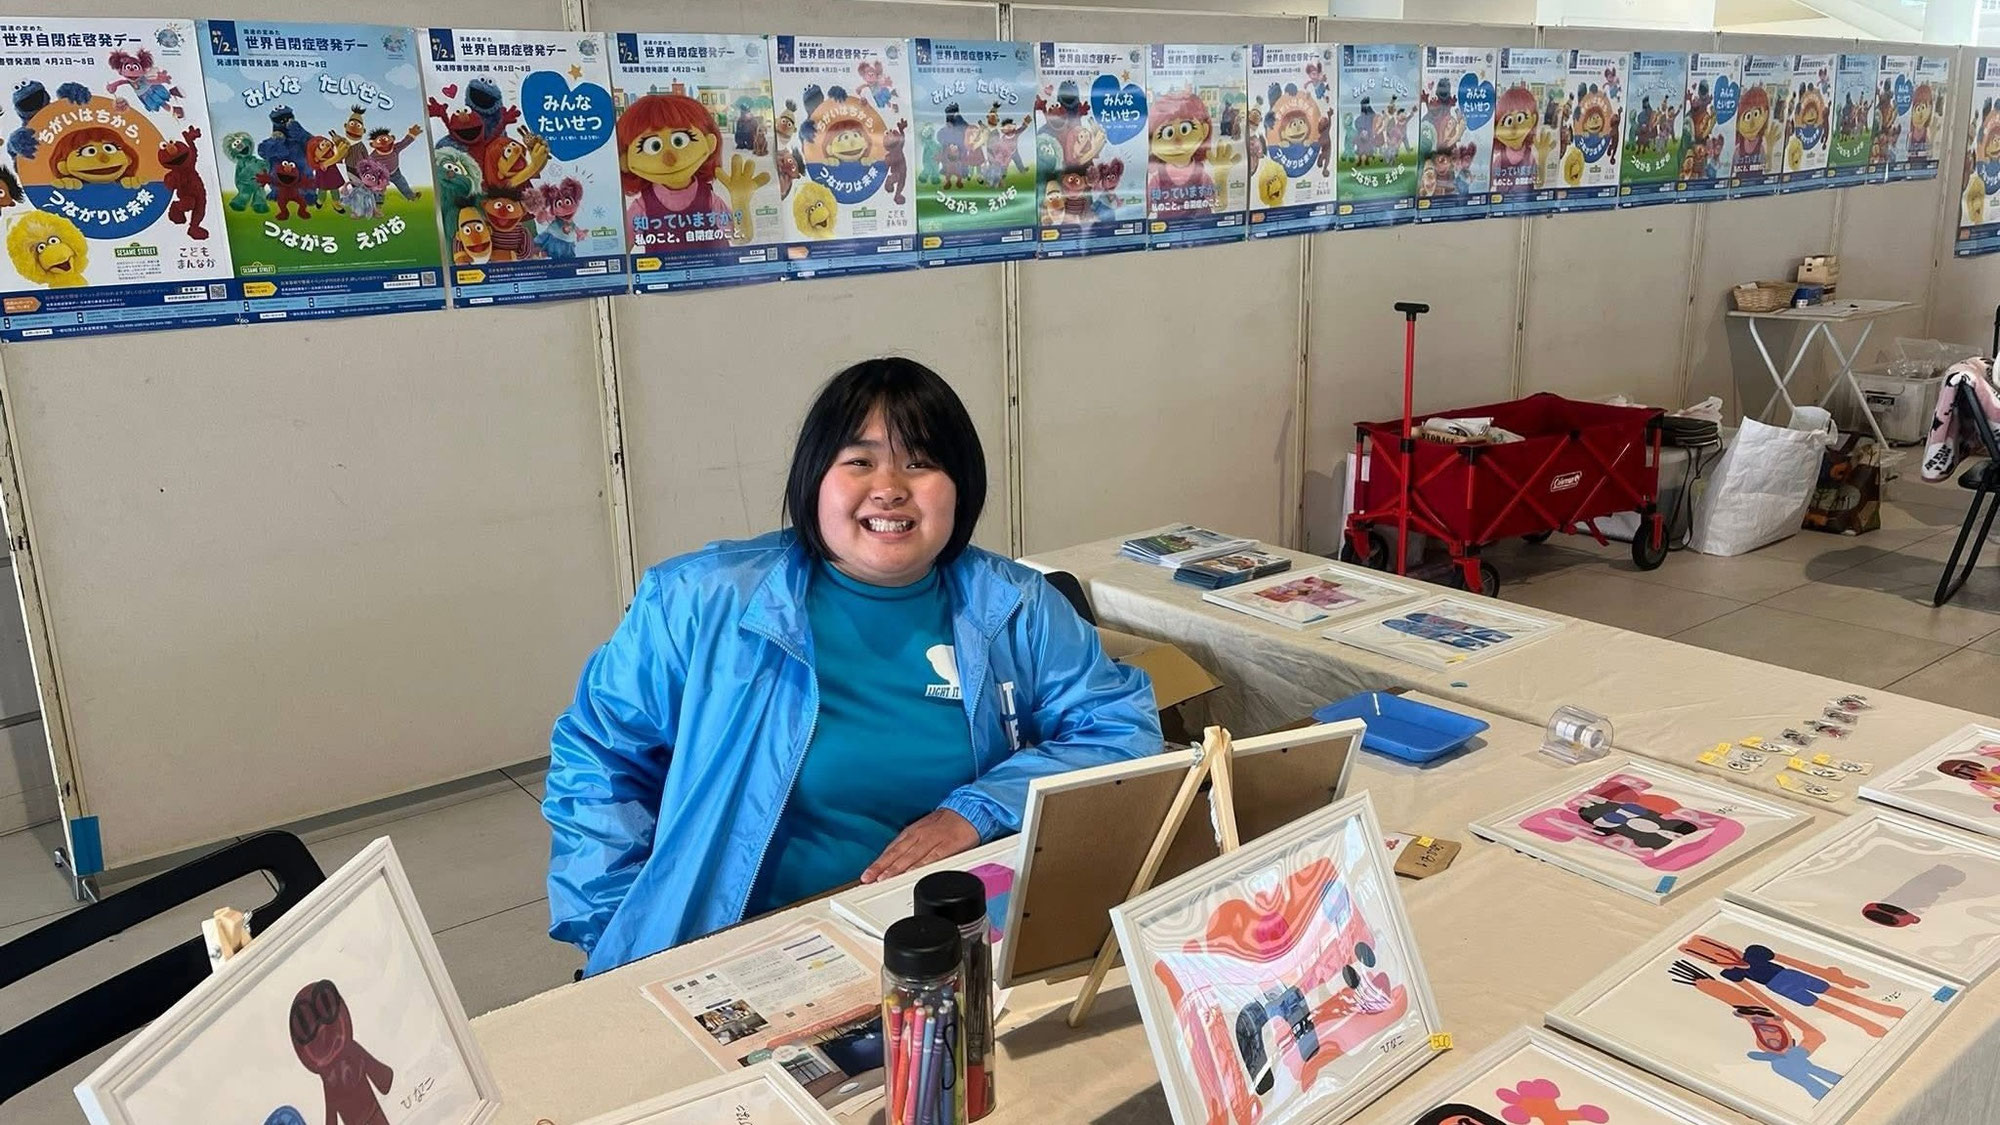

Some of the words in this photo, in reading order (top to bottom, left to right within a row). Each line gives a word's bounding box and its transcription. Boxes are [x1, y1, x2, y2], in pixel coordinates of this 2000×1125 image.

[3, 33, 142, 48] 世界自閉症啓発デー
[244, 35, 369, 51] 世界自閉症啓発デー
[461, 43, 567, 57] 世界自閉症啓発デー
[644, 47, 735, 58] 世界自閉症啓発デー
[799, 48, 878, 60] 世界自閉症啓発デー
[243, 74, 301, 107] みんな
[319, 73, 395, 110] たいせつ
[931, 80, 968, 105] みんな
[976, 79, 1019, 106] たいせつ
[1466, 88, 1487, 99] みんな
[543, 94, 592, 112] みんな
[1103, 92, 1134, 106] みんな
[1463, 101, 1491, 113] たいせつ
[1100, 109, 1141, 122] たいせつ
[538, 115, 602, 132] たいせつ
[49, 188, 155, 226] つながりは未来
[936, 190, 979, 215] つながる
[988, 185, 1017, 212] えがお
[264, 220, 339, 254] つながる
[356, 215, 406, 250] えがお
[179, 247, 210, 258] こども
[178, 259, 216, 270] まんなか
